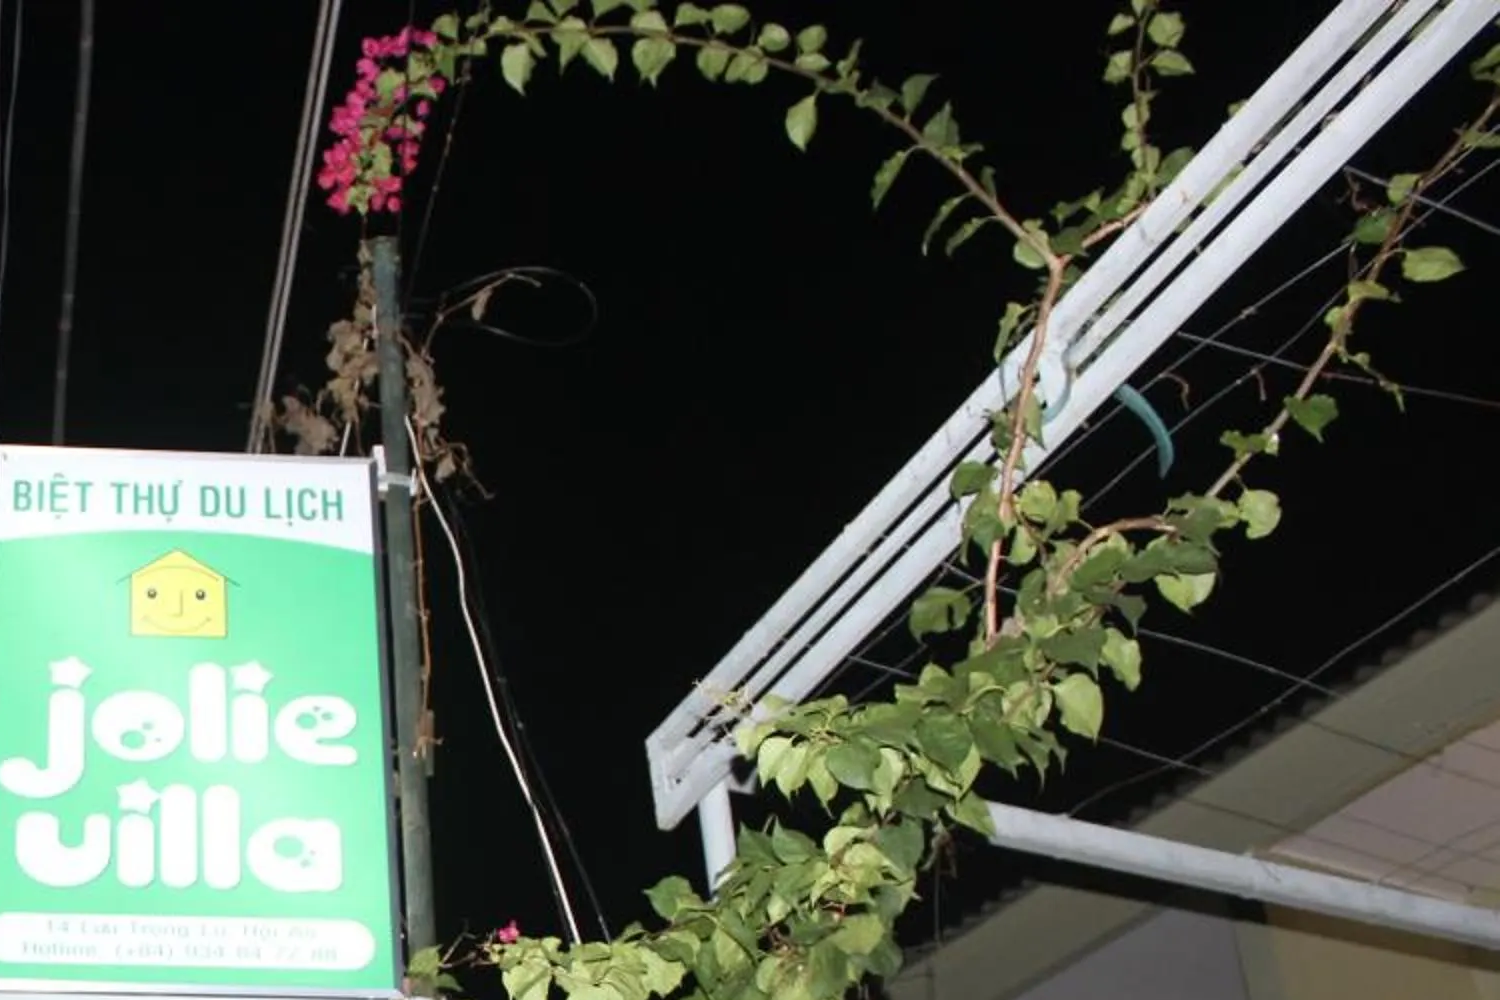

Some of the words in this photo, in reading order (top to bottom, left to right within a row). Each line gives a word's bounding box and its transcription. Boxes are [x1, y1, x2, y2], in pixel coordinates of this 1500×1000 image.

[13, 472, 93, 519] BIỆT
[110, 478, 183, 522] THỰ
[200, 485, 246, 518] DU
[265, 487, 343, 526] LỊCH
[15, 777, 343, 892] villa
